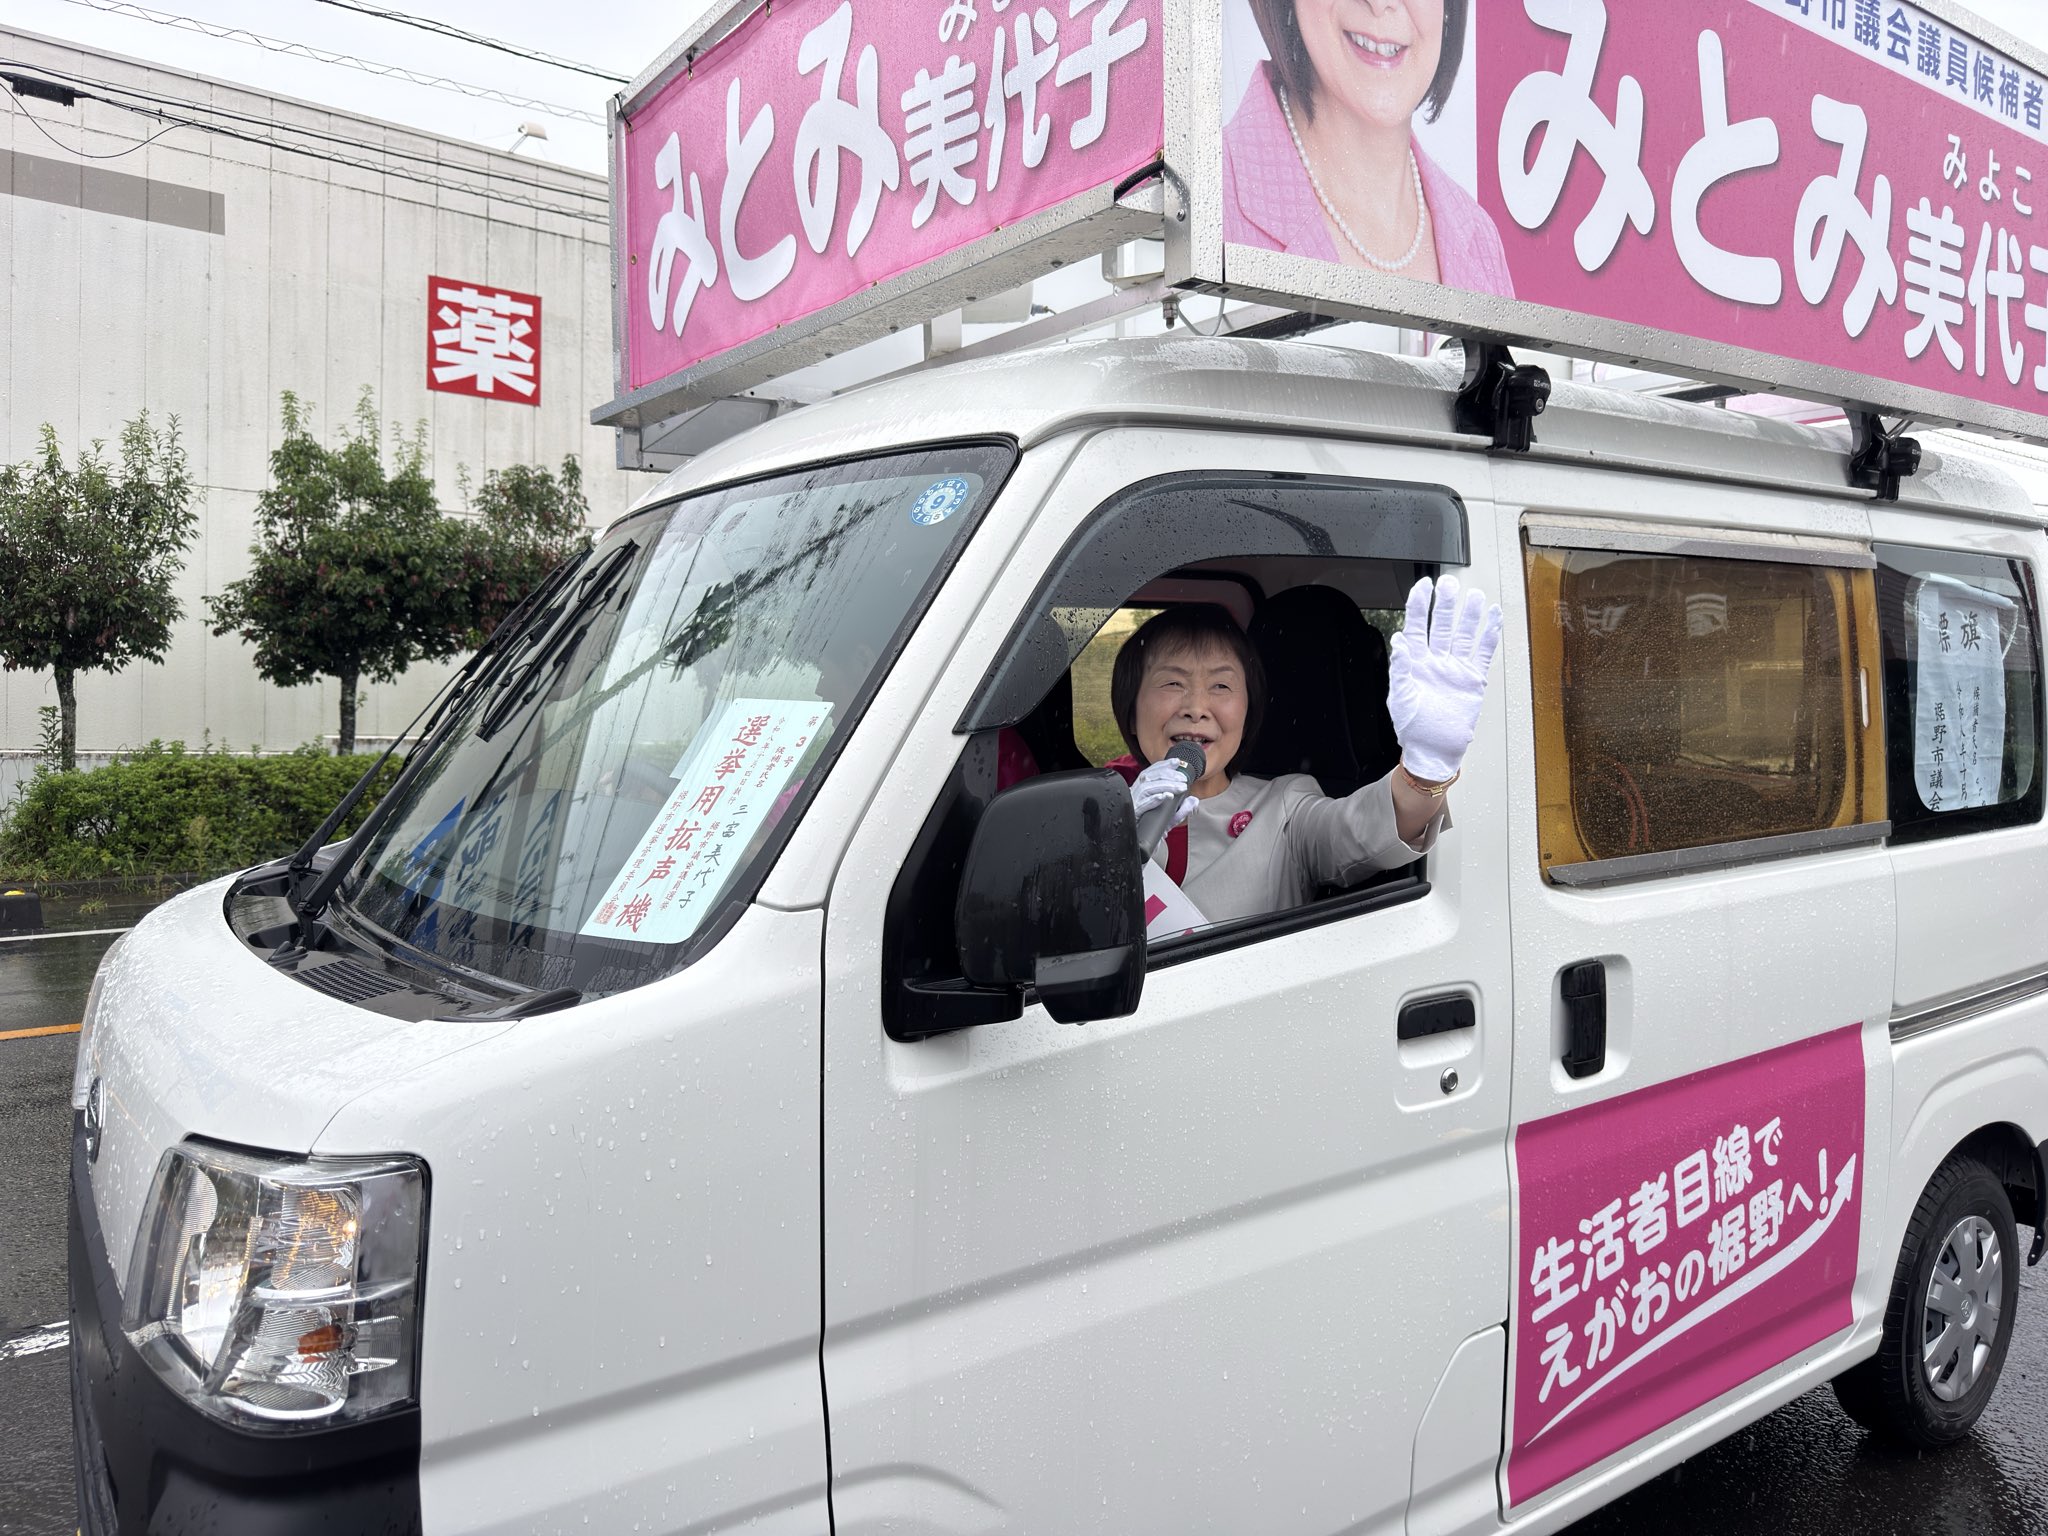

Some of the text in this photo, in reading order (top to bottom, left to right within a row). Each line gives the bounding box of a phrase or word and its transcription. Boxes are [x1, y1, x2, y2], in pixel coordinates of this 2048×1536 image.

[1785, 0, 2043, 130] 市議会議員候補者
[1943, 134, 2033, 216] みよこ
[432, 287, 537, 397] 薬
[930, 494, 946, 510] 9
[1957, 681, 1968, 809] 令和八年十月
[615, 714, 771, 933] 選挙用拡声機
[1530, 1116, 1784, 1324] 生活者目線で
[1538, 1147, 1830, 1403] えがおの裾野へ!
